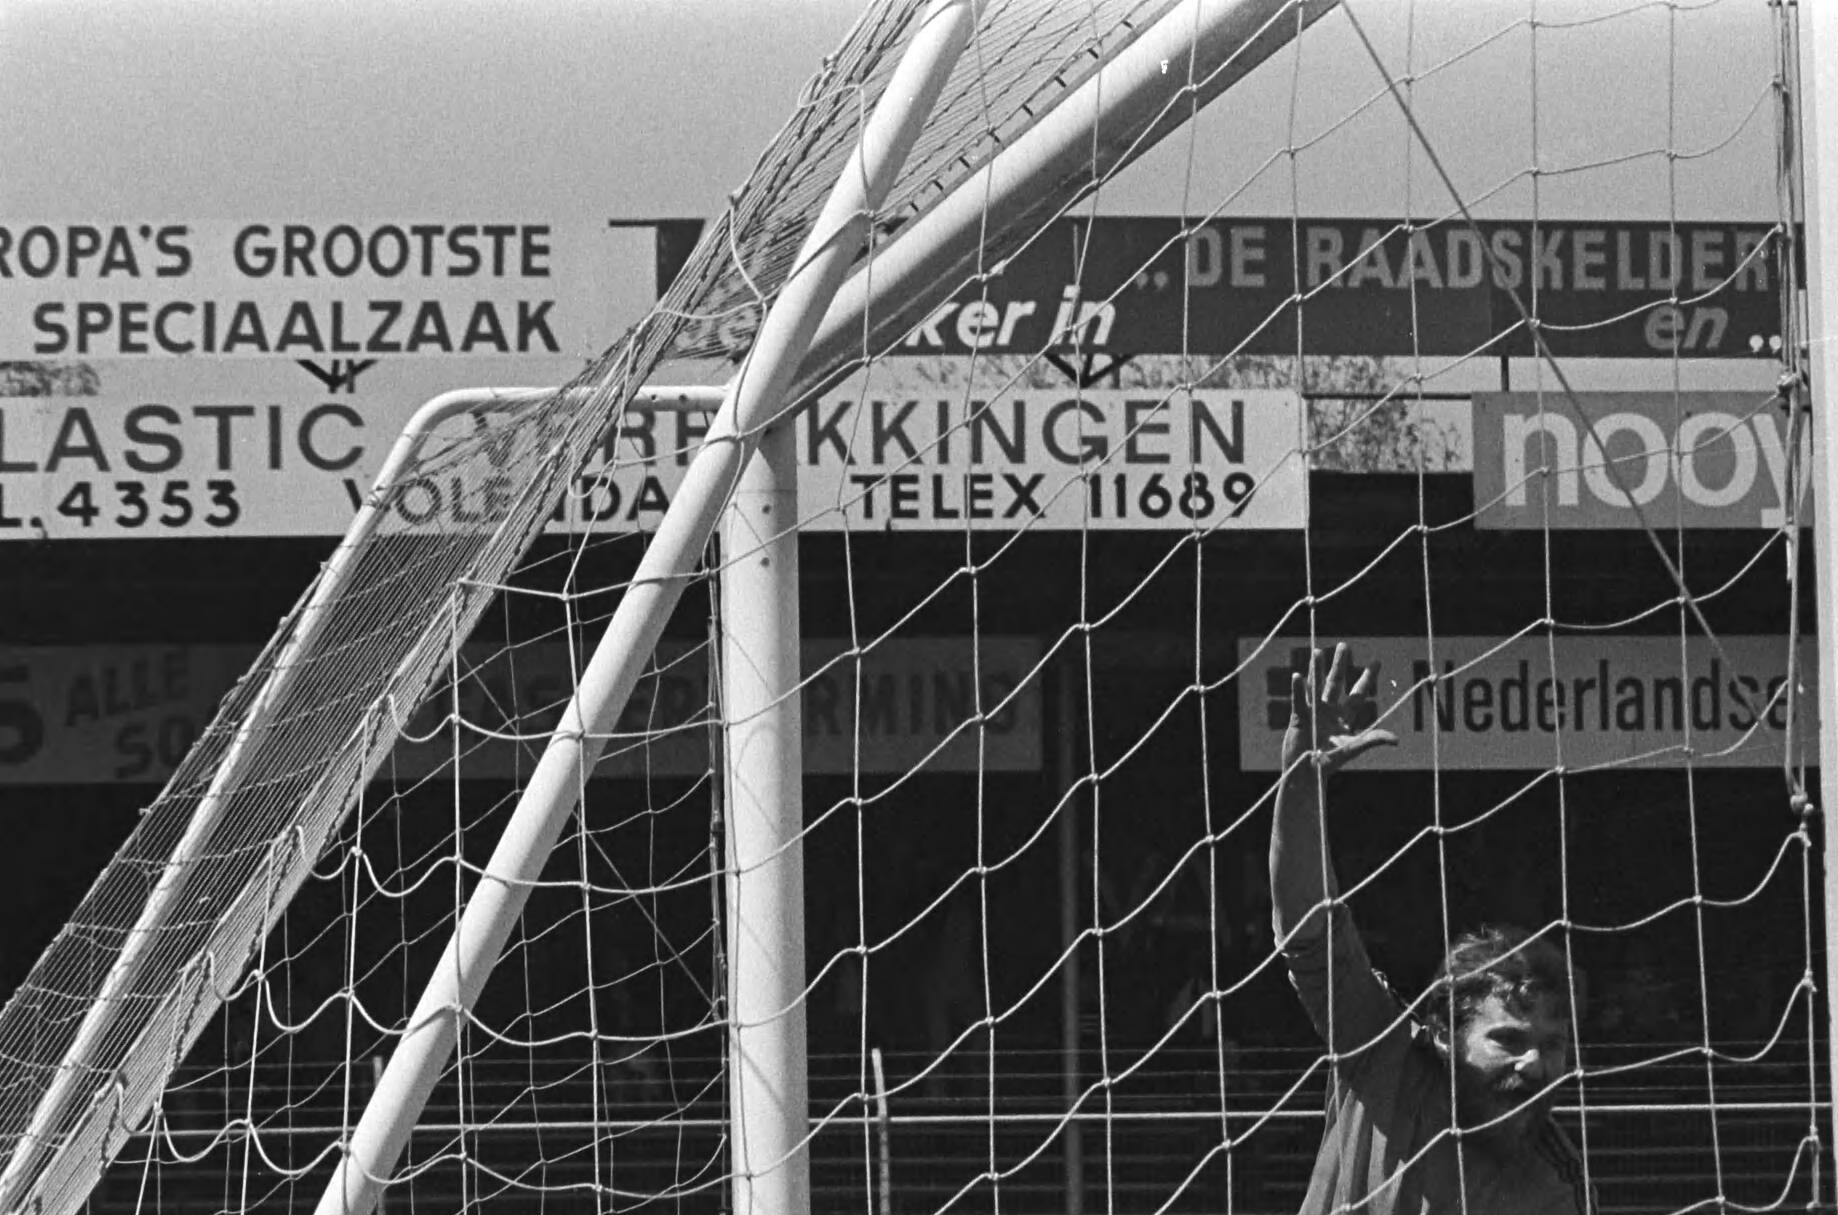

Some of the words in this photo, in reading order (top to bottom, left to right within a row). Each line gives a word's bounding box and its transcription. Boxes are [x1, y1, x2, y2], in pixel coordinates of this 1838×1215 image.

[233, 224, 552, 278] GROOTSTE
[1049, 284, 1117, 347] in
[1306, 226, 1769, 293] RAADSKELDER
[1644, 306, 1729, 350] en
[33, 301, 560, 354] SPECIAALZAAK
[0, 403, 366, 473] LASTIC
[849, 473, 1047, 520] TELEX
[1088, 472, 1256, 520] 11689
[65, 645, 190, 727] ALLE
[1411, 658, 1797, 735] Nederlandse
